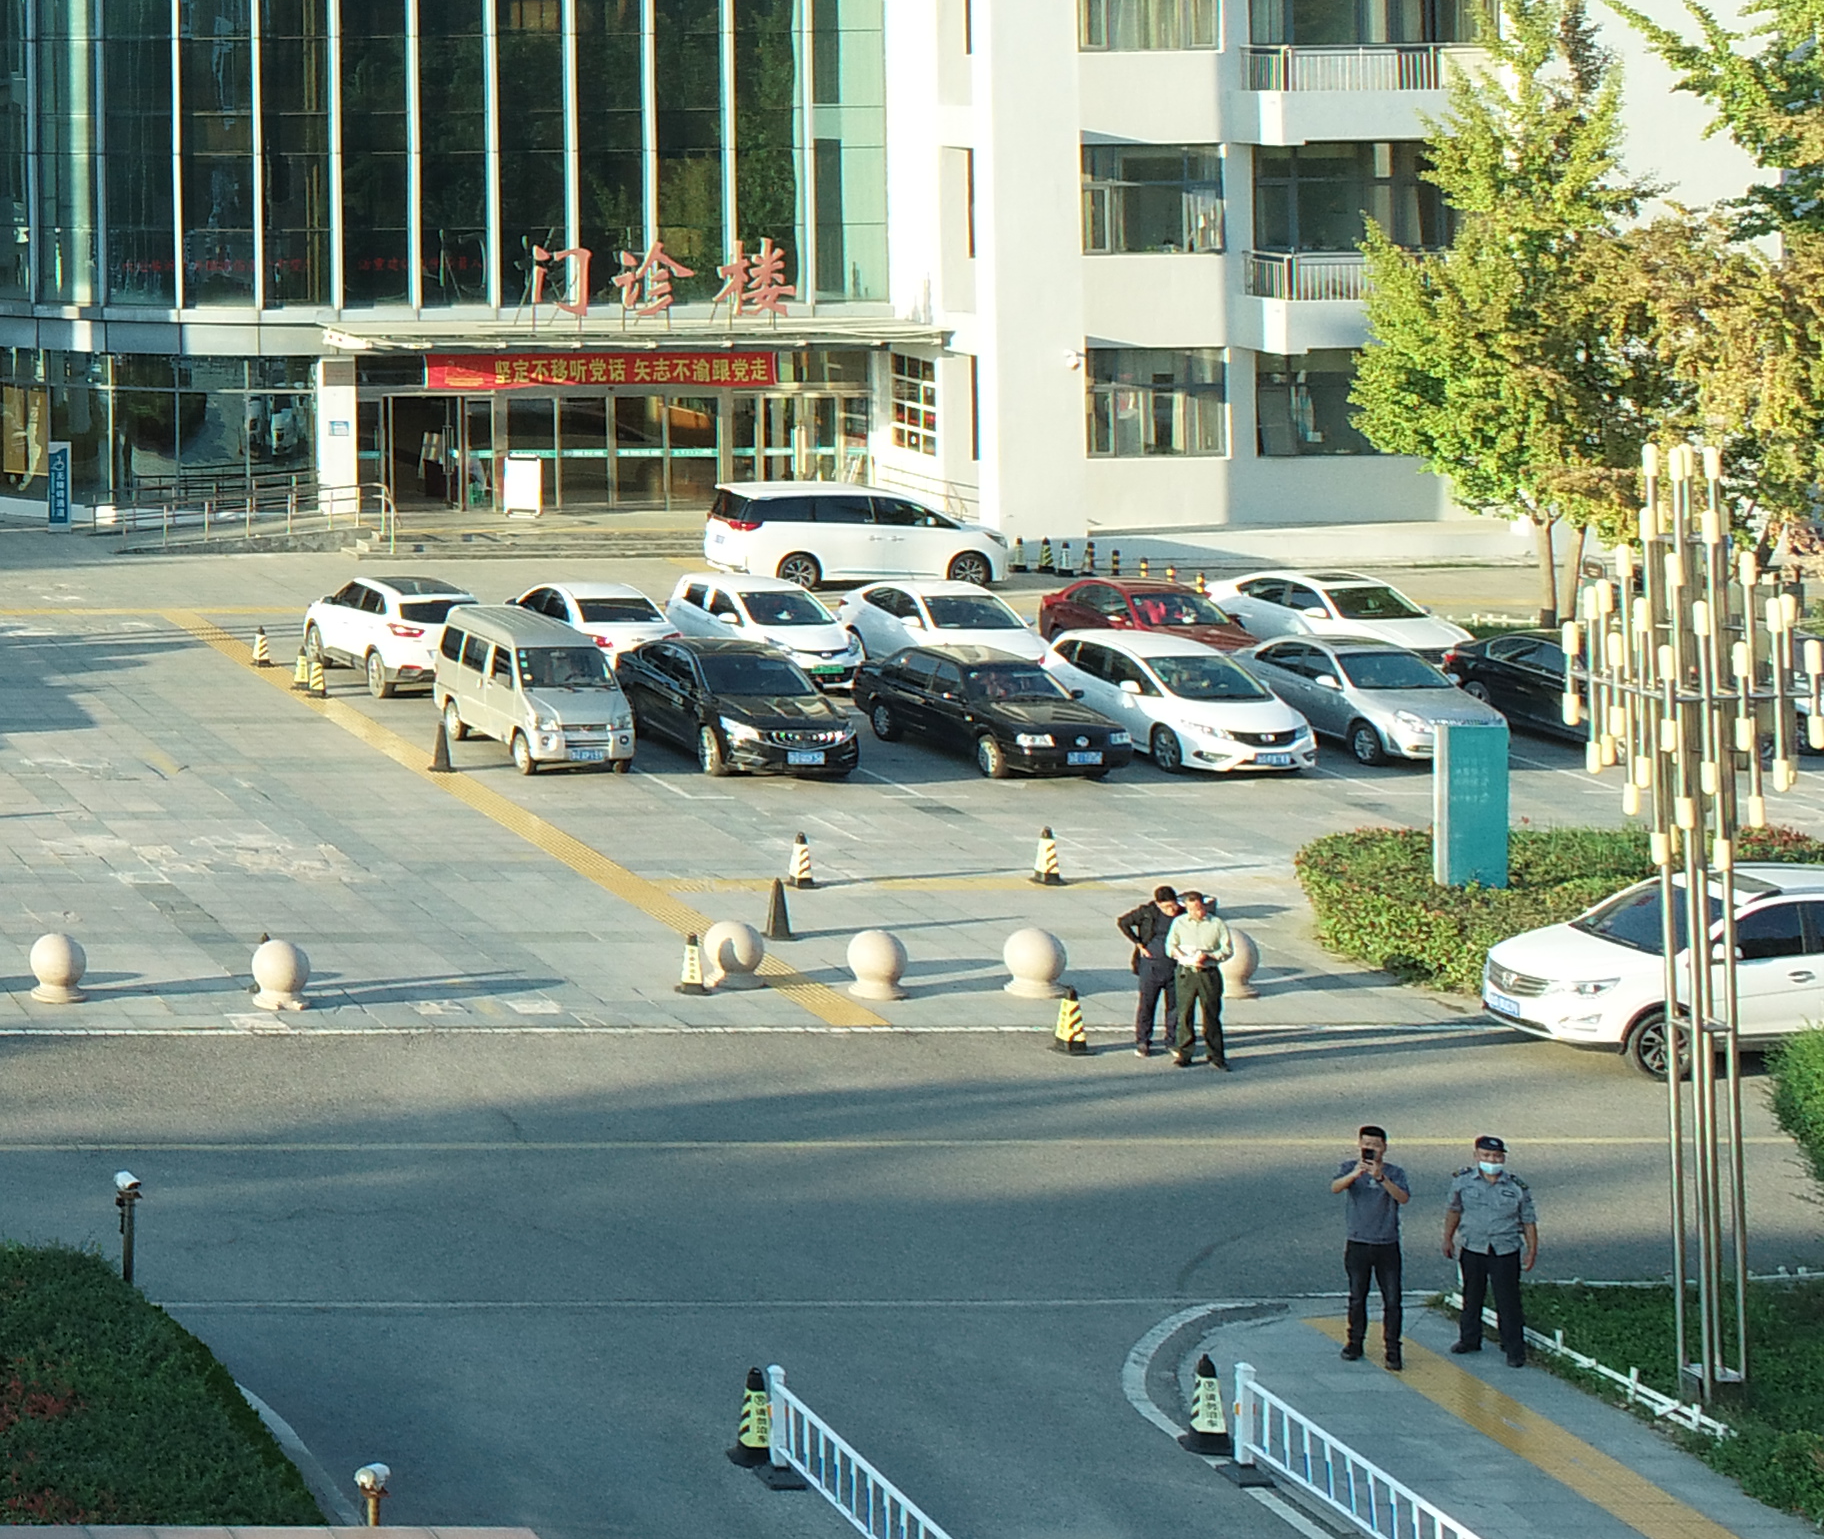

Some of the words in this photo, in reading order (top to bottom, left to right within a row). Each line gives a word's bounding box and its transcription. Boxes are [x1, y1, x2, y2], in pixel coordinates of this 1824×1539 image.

[531, 238, 797, 317] 门诊楼
[494, 358, 626, 384] 坚定不移听党话
